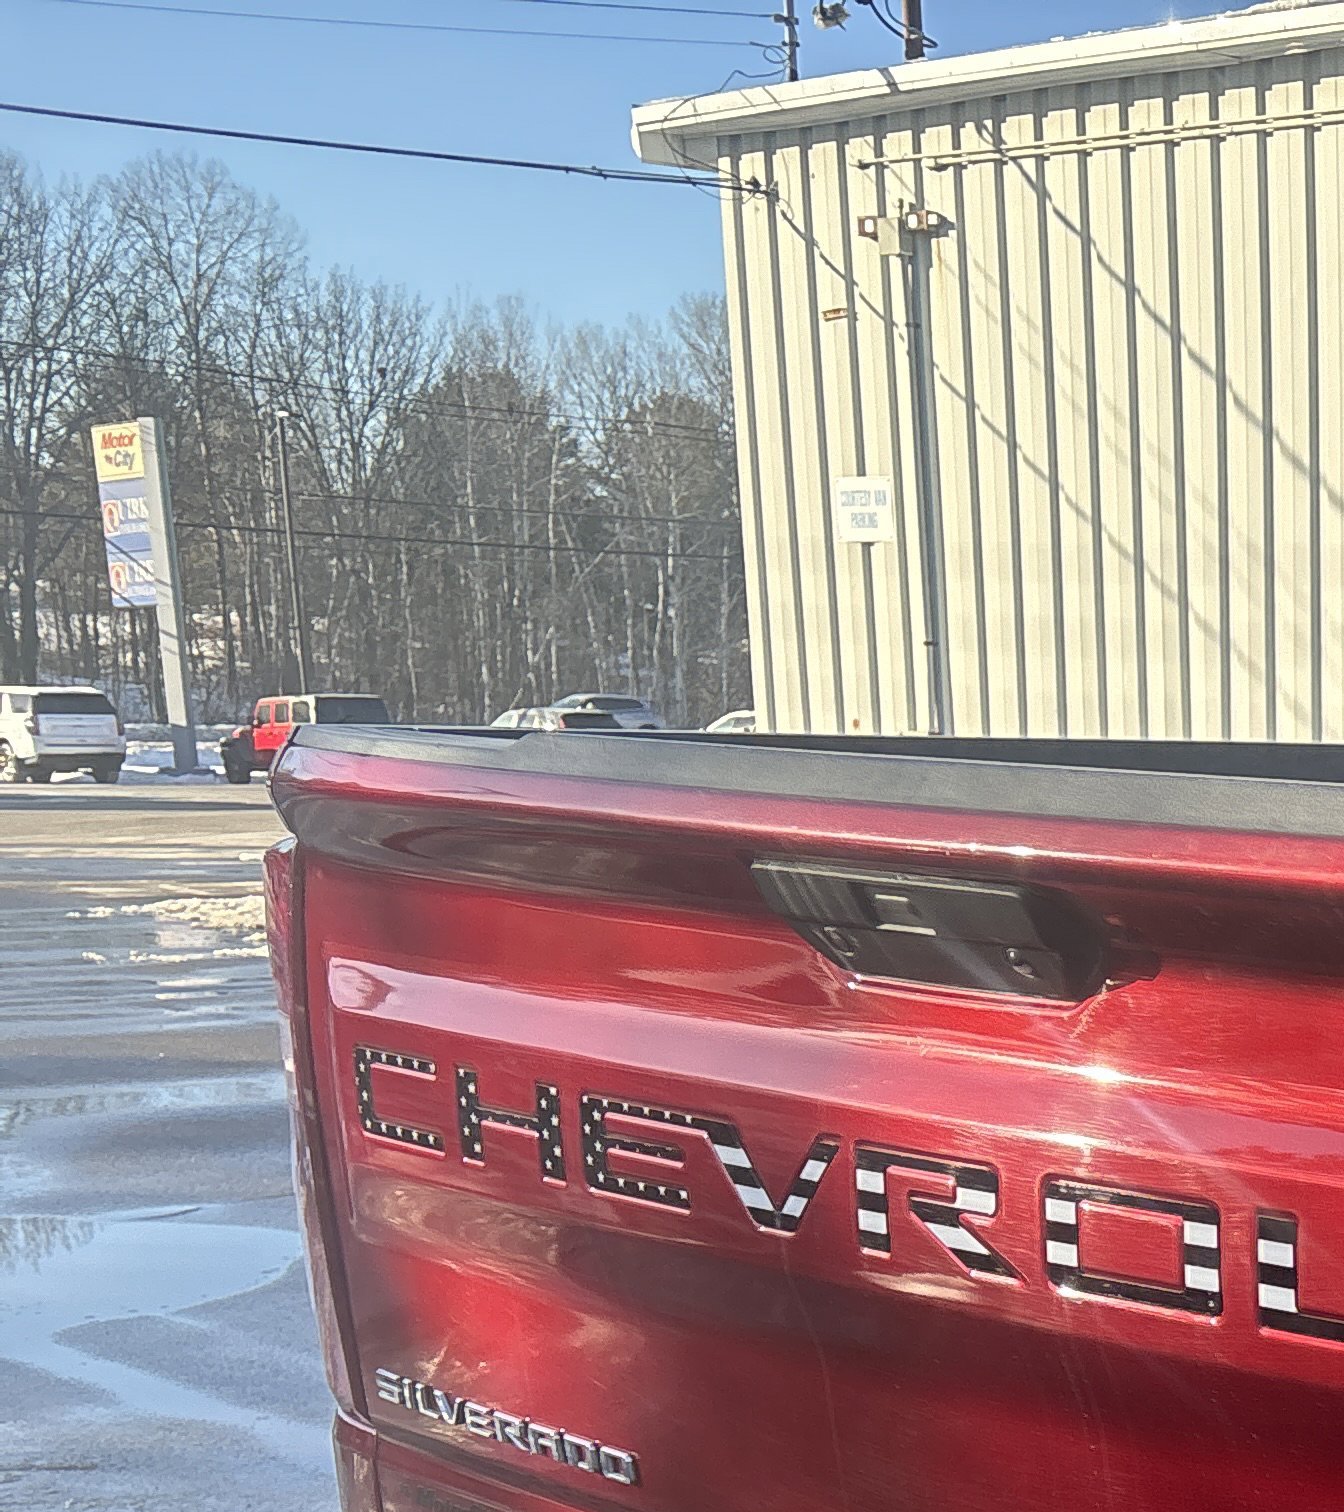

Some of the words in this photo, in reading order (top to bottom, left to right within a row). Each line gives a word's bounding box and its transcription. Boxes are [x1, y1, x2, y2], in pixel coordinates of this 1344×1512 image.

[101, 432, 136, 449] Motor
[114, 450, 136, 470] City
[375, 1368, 640, 1485] SILVERADO
